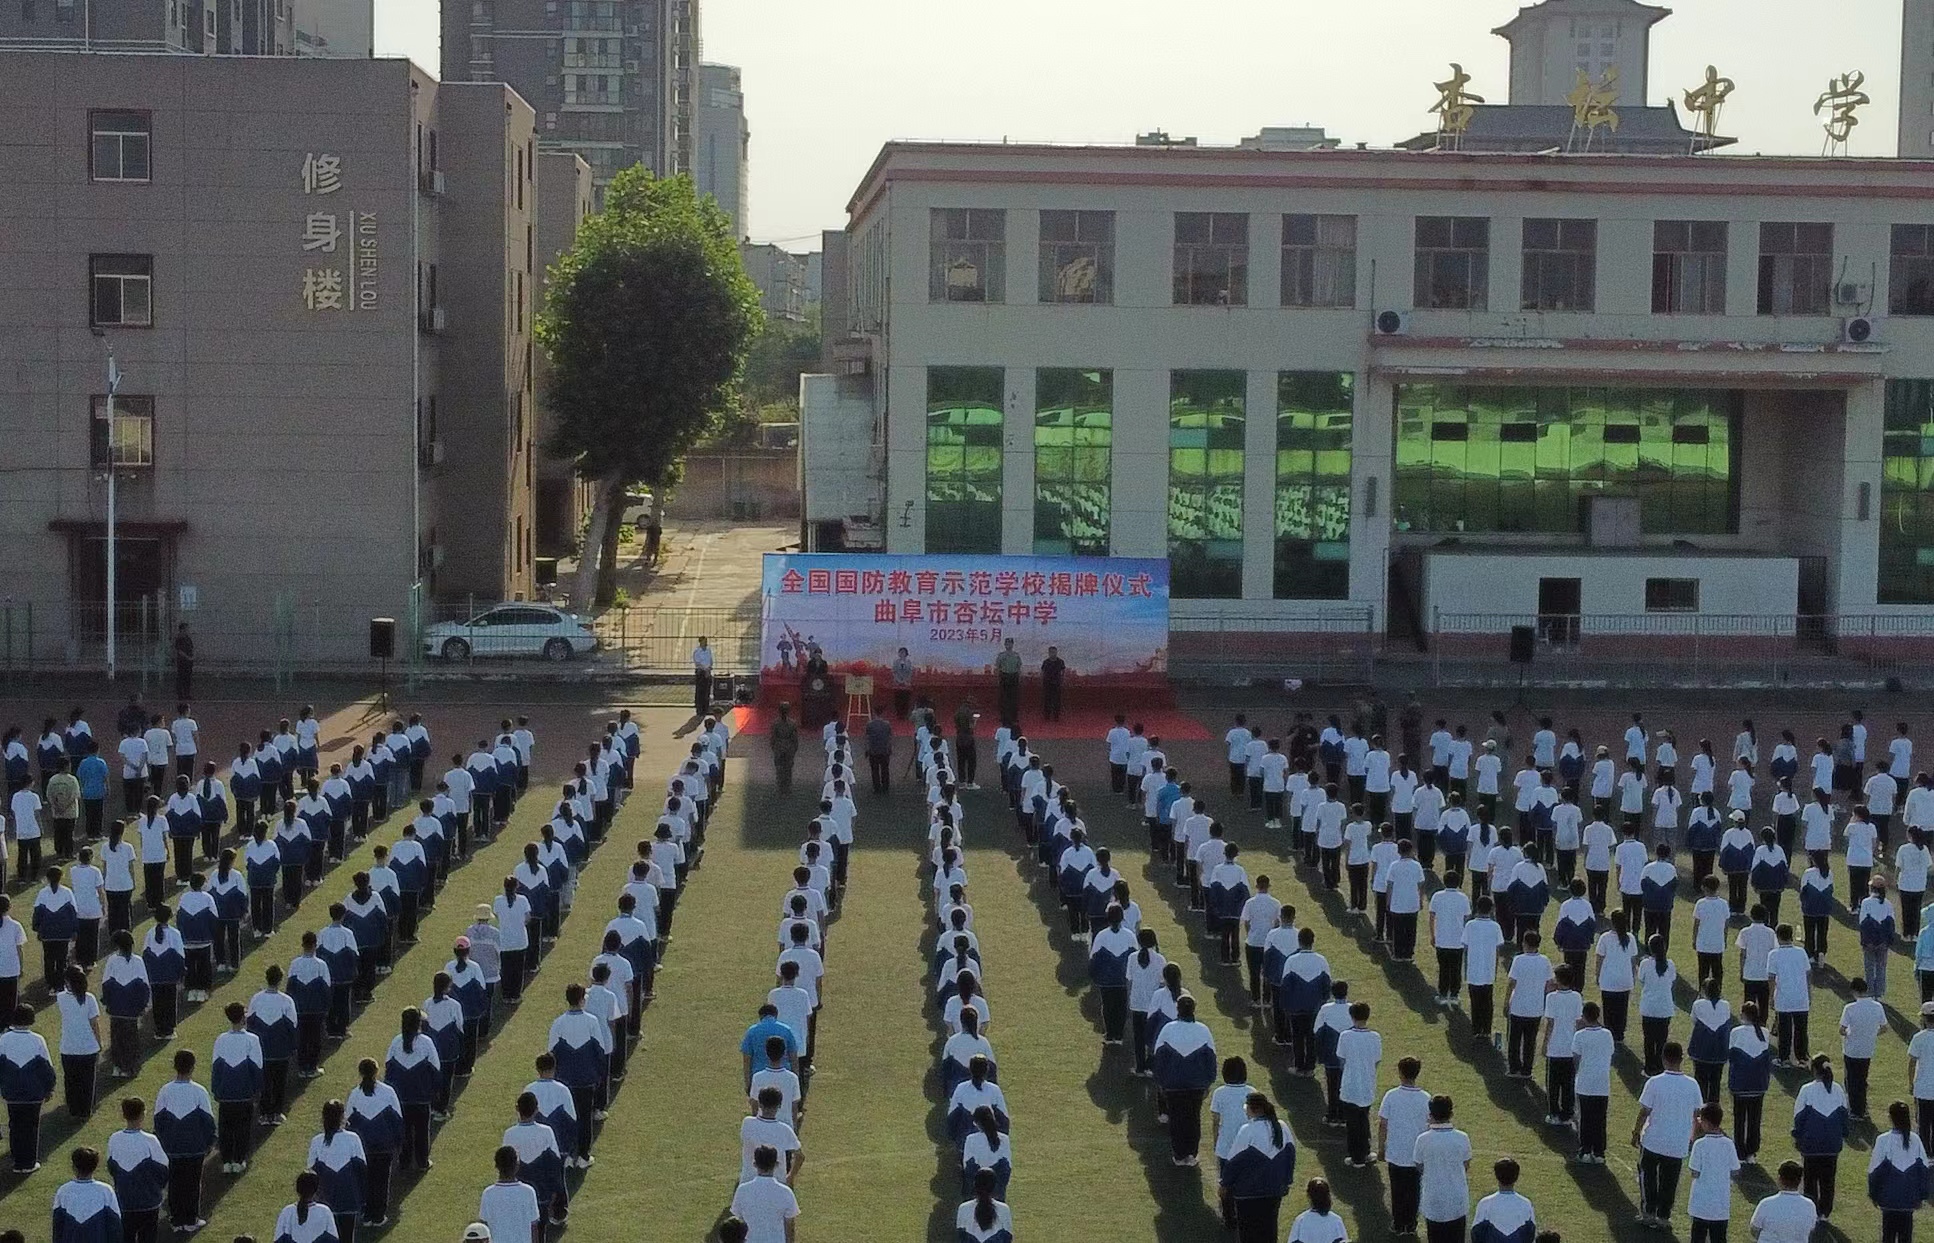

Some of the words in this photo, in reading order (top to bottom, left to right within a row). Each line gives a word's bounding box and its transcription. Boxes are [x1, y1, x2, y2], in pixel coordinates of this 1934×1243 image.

[301, 152, 342, 311] 修身楼
[360, 212, 377, 235] XIU
[360, 239, 377, 277] SHEN
[360, 281, 377, 310] LOU
[781, 568, 1153, 598] 全国国防教育示范学校揭牌仪式
[874, 599, 1058, 625] 曲阜市杏坛中学
[929, 628, 1003, 644] 2023年5月
